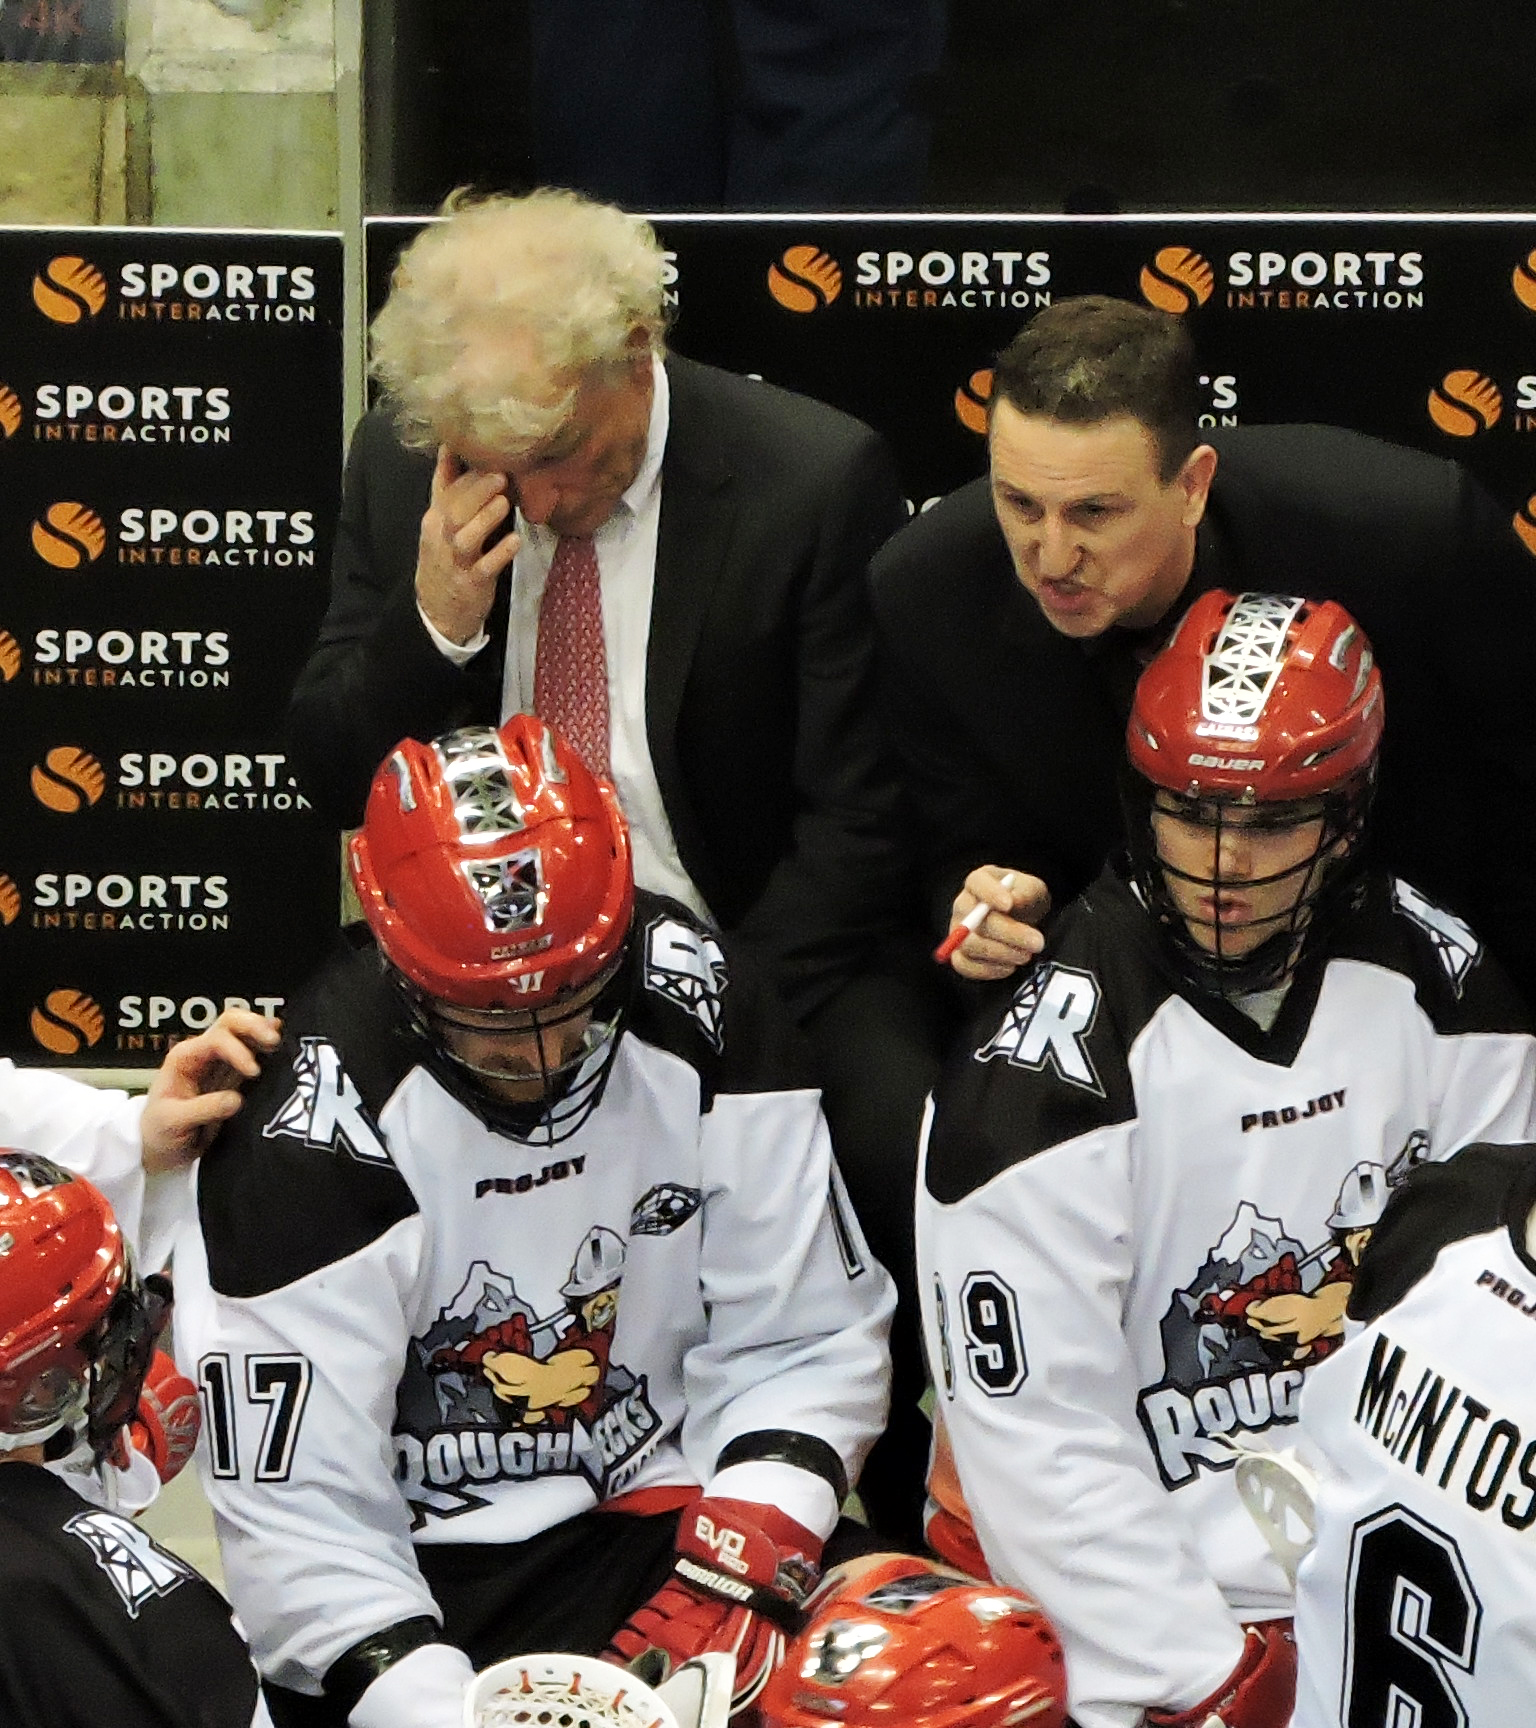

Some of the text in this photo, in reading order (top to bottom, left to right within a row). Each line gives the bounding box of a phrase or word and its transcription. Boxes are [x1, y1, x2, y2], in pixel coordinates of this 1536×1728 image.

[120, 263, 315, 299] SPORTS
[856, 251, 1051, 287] SPORTS
[1228, 251, 1423, 287] SPORTS
[120, 302, 315, 322] INTERACTION
[856, 290, 1051, 309] INTERACTION
[1228, 290, 1423, 309] INTERACTION
[35, 384, 230, 420] SPORTS
[35, 423, 230, 444] INTERACTION
[119, 508, 314, 544] SPORTS
[119, 547, 314, 567] INTERACTION
[35, 629, 229, 665] SPORTS
[35, 668, 229, 687] INTERACTION
[119, 753, 297, 788] SPORT
[1187, 753, 1266, 772] BAUER
[34, 873, 228, 909] SPORTS
[34, 912, 228, 930] INTERACTION
[1241, 1089, 1347, 1133] PROJOY
[198, 1352, 311, 1482] 17
